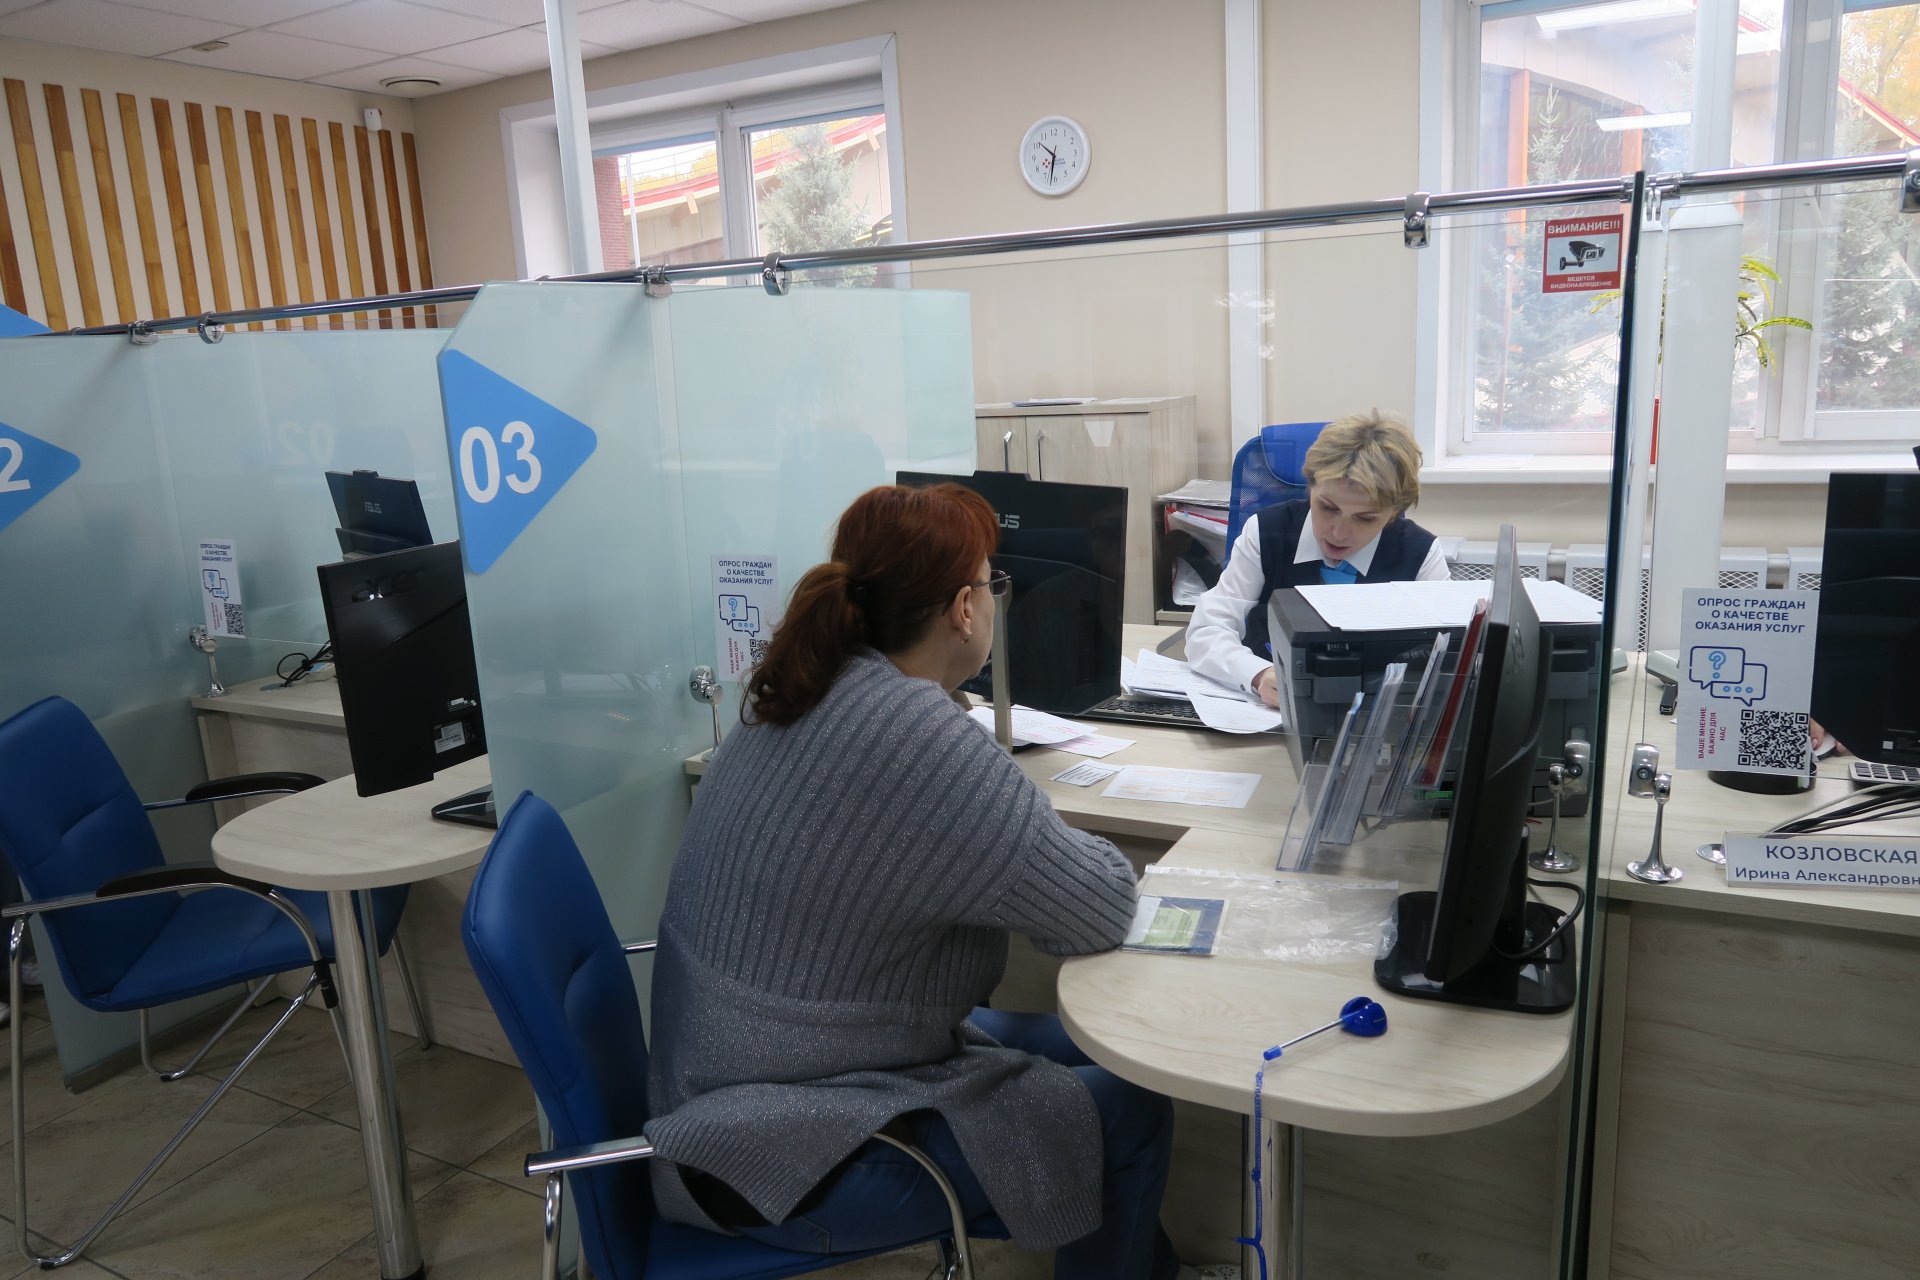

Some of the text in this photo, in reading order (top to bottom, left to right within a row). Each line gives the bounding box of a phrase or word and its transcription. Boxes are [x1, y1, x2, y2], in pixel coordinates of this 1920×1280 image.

[1547, 220, 1620, 234] ВНИМАНИЕ!!!
[1550, 280, 1612, 289] ВИДЕОНАБЛЮДЕНИЕ
[460, 420, 542, 503] 03
[994, 513, 1020, 529] US
[742, 561, 772, 569] ГРАЖДАН
[732, 569, 765, 577] КАЧЕСТВЕ
[719, 576, 753, 584] ОКАЗАНИЯ
[1697, 597, 1806, 610] ОПРОС ГРАЖДАН
[1711, 609, 1789, 621] О КАЧЕСТВЕ
[1695, 621, 1806, 633] ОКАЗАНИЯ УСЛУГ
[1765, 845, 1918, 865] КОЗЛОВСКАЯ
[1735, 867, 1790, 881] Ирина
